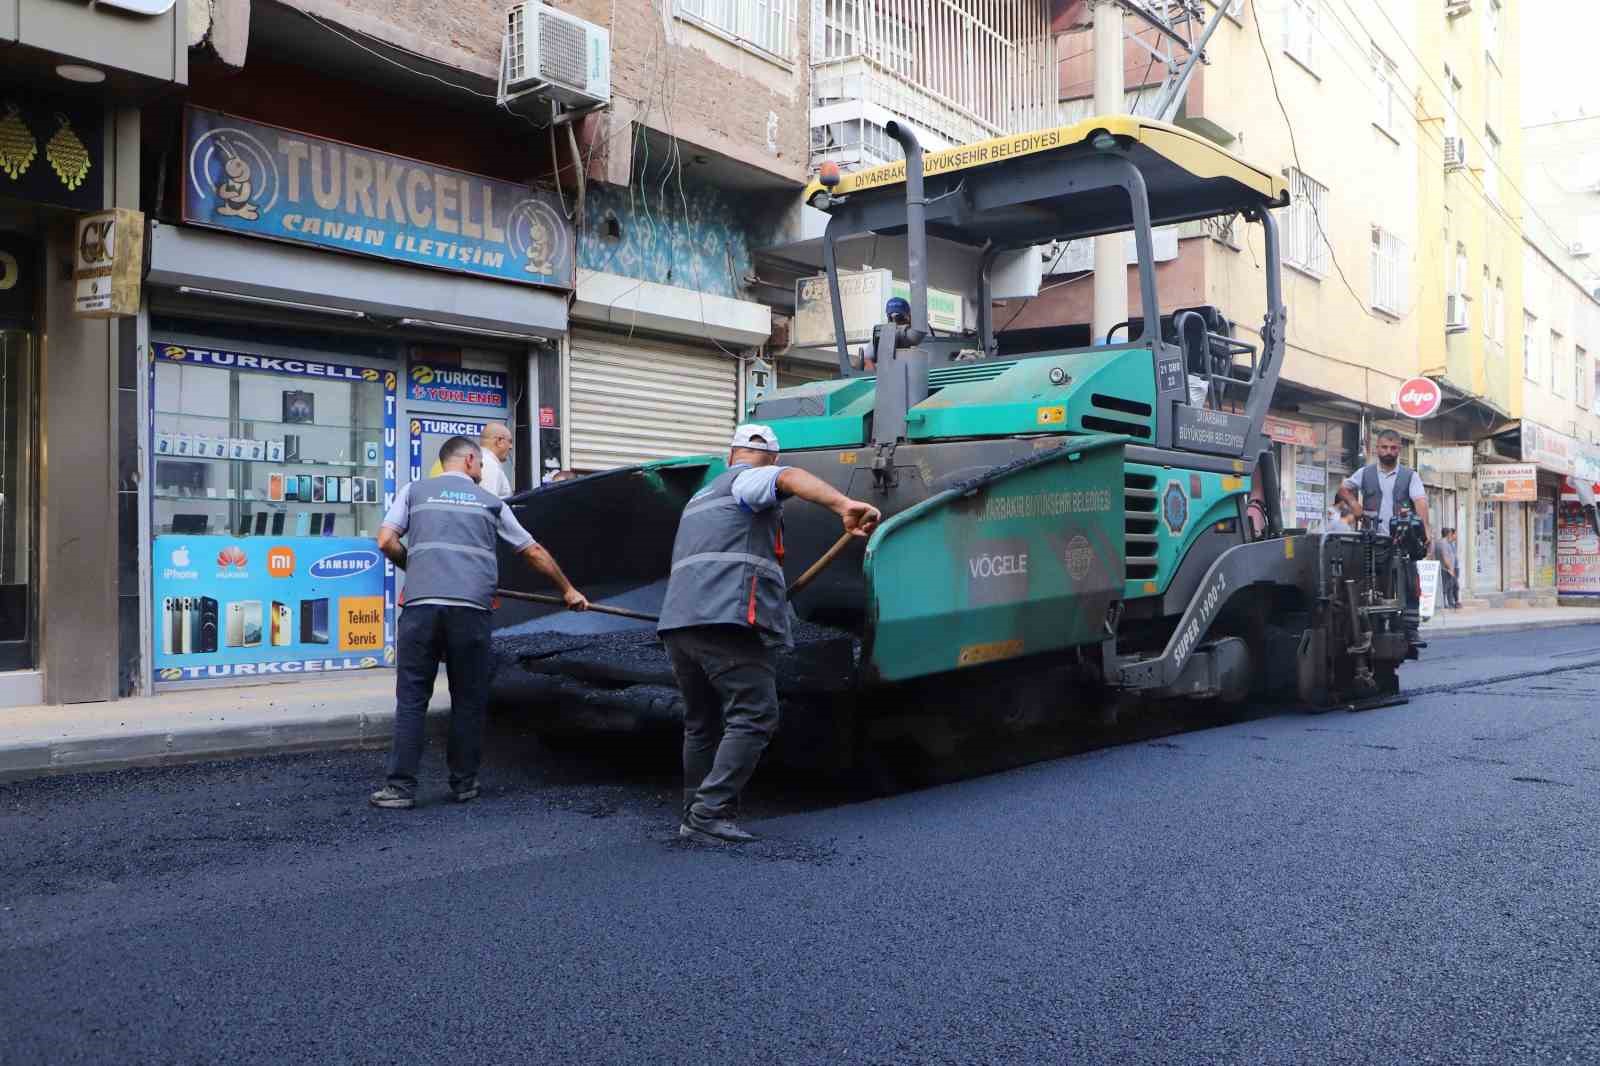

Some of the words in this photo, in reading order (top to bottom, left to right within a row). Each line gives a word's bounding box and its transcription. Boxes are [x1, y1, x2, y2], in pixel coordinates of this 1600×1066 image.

[923, 146, 988, 173] ÜYÜKŞEHİR
[991, 131, 1061, 159] BELEDİYESİ
[277, 136, 505, 243] TURKCELL
[282, 213, 385, 246] CANAN
[394, 231, 505, 267] İLETİŞİM
[186, 348, 362, 380] TURKCELL
[434, 370, 504, 389] TURKCELL
[1402, 388, 1434, 406] dyo
[319, 559, 371, 570] SAMSUNG
[969, 553, 1028, 578] VÖGELE
[348, 609, 381, 626] Teknik
[348, 631, 377, 646] Servis
[1174, 617, 1200, 668] SUPER
[183, 656, 361, 678] TURKCELL
